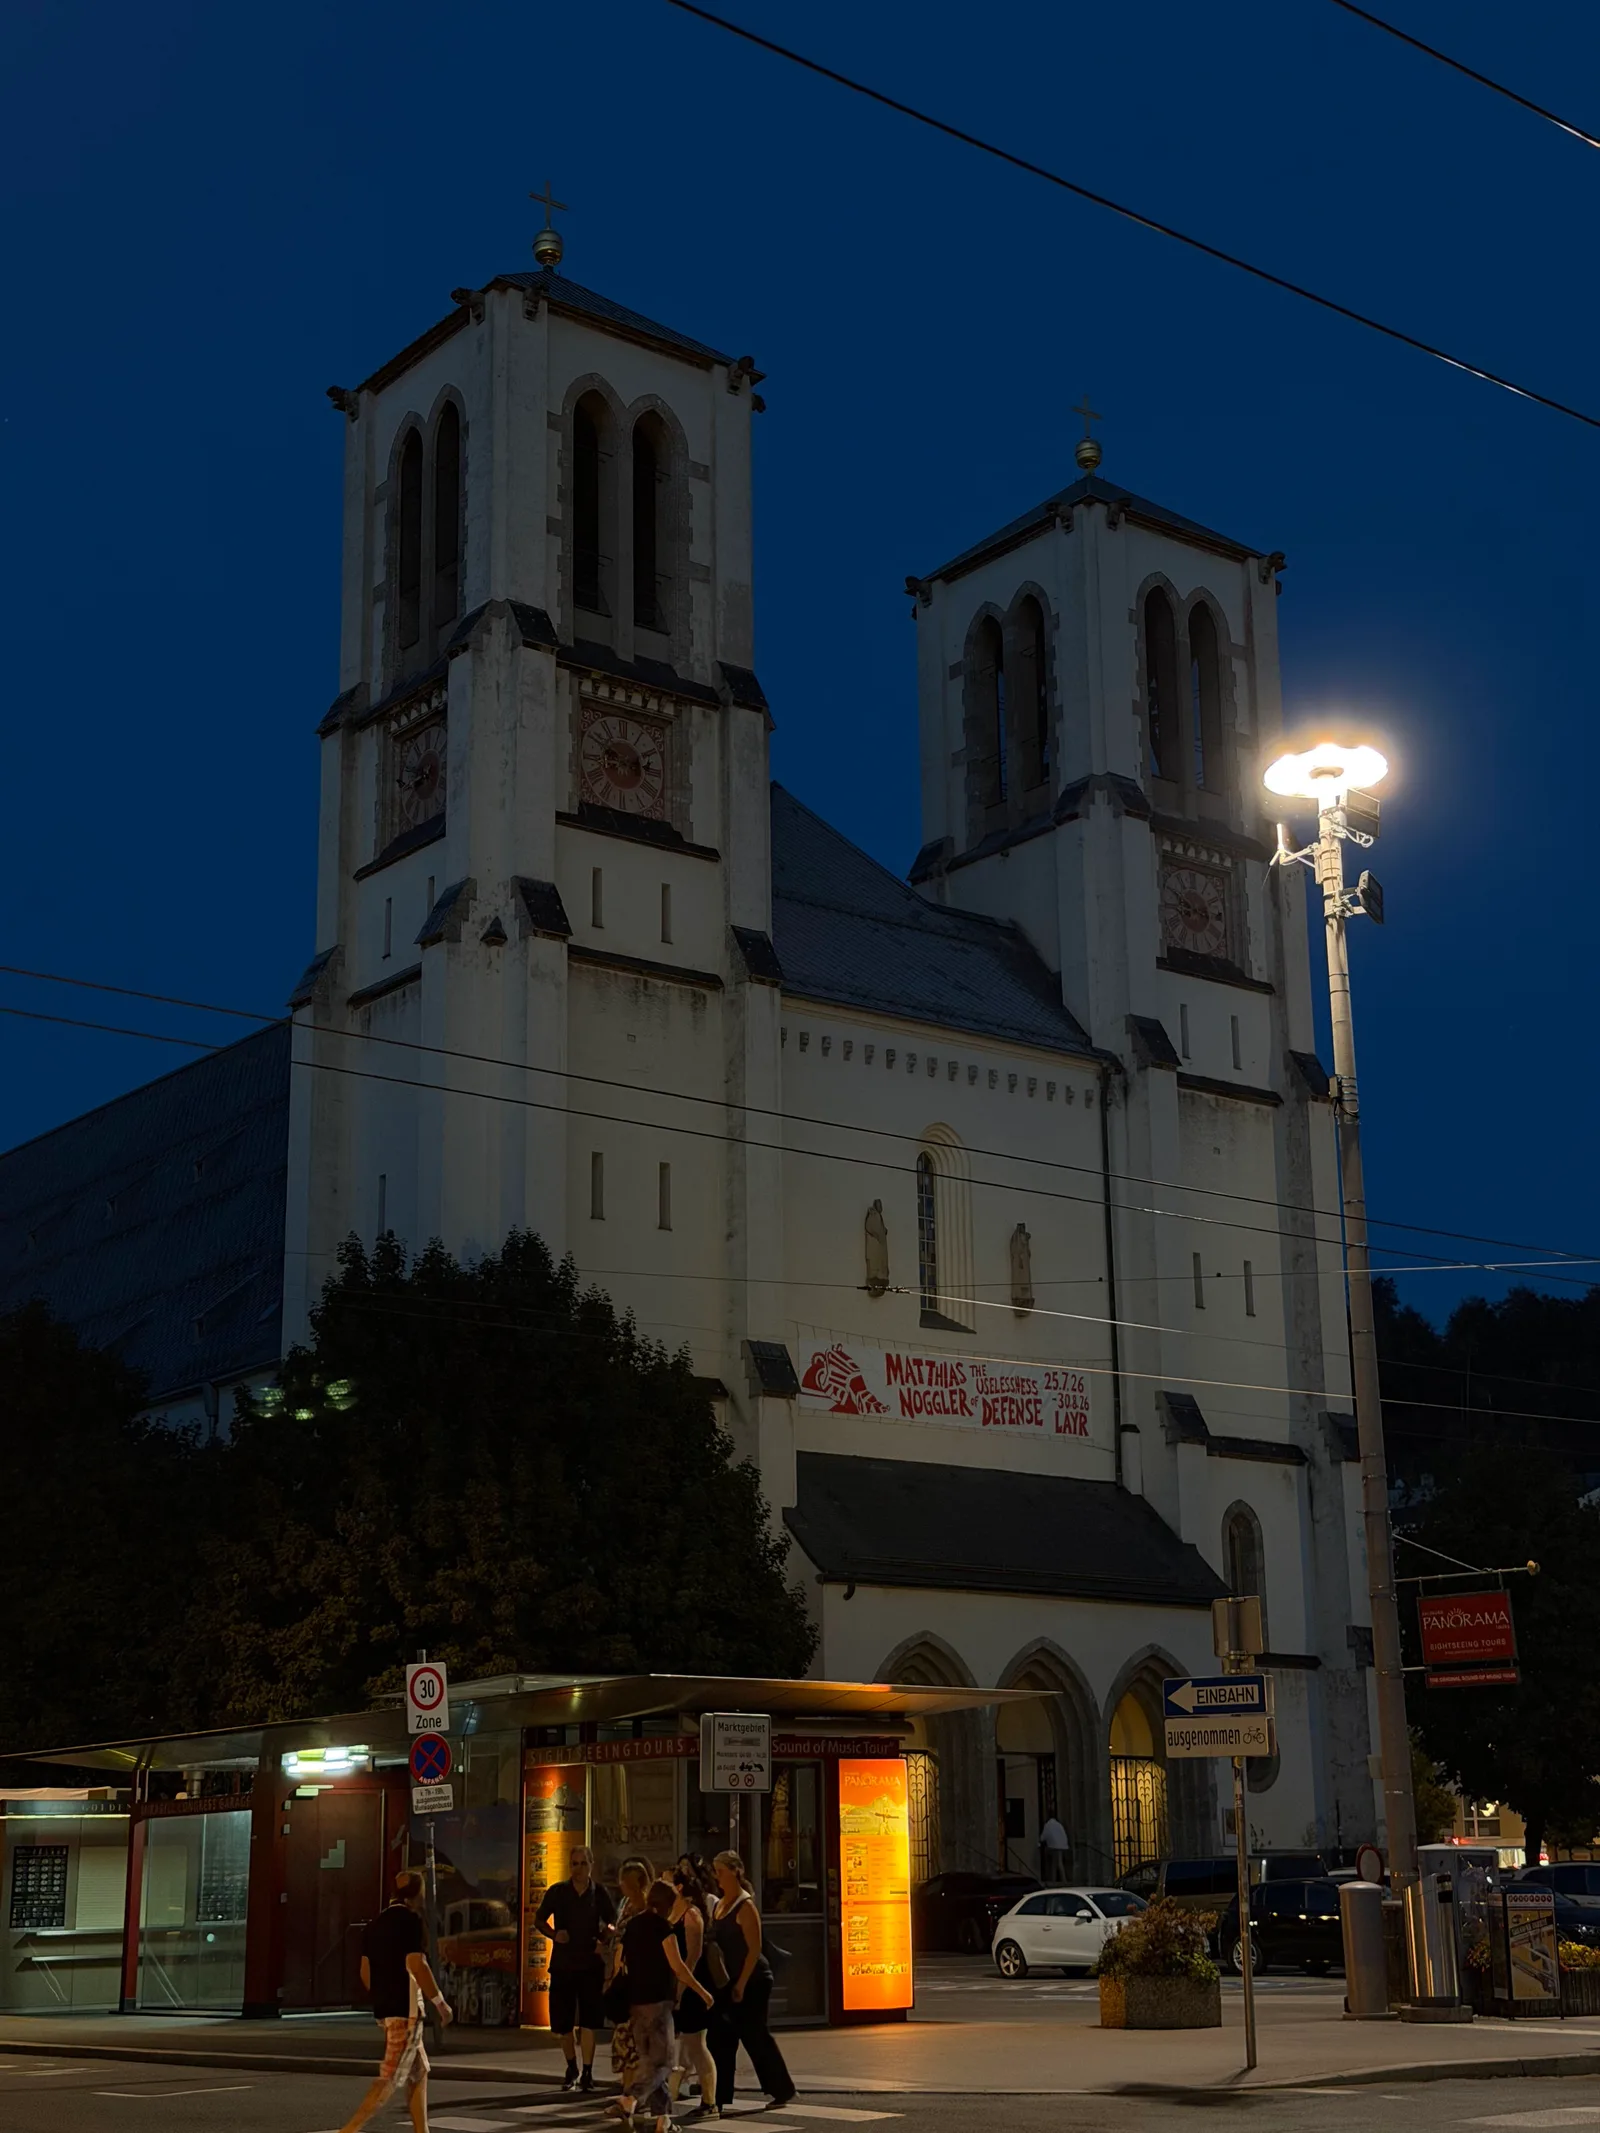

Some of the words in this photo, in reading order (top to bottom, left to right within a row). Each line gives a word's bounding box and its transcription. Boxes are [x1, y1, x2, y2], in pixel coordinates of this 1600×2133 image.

[886, 1352, 967, 1389] MATTHIAS
[969, 1364, 987, 1378] THE
[976, 1375, 1039, 1396] USELESSNESS
[1044, 1371, 1085, 1393] 25.7.26
[899, 1387, 974, 1419] NOGGLER
[970, 1395, 979, 1408] OF
[982, 1395, 1044, 1427] DEFENSE
[1055, 1410, 1090, 1437] LAYR
[1423, 1610, 1510, 1630] PANORAMA
[1429, 1640, 1479, 1651] SIGHTSEEING
[1481, 1638, 1507, 1647] TOURS
[420, 1680, 435, 1698] 30
[1196, 1687, 1255, 1704] EINBAHN
[416, 1715, 442, 1729] Zone
[718, 1722, 765, 1734] Marktgebiet
[772, 1740, 811, 1753] Sound
[813, 1740, 826, 1753] of
[828, 1741, 860, 1754] Music
[1167, 1729, 1241, 1750] ausgenommen
[418, 1774, 444, 1786] ANFANG
